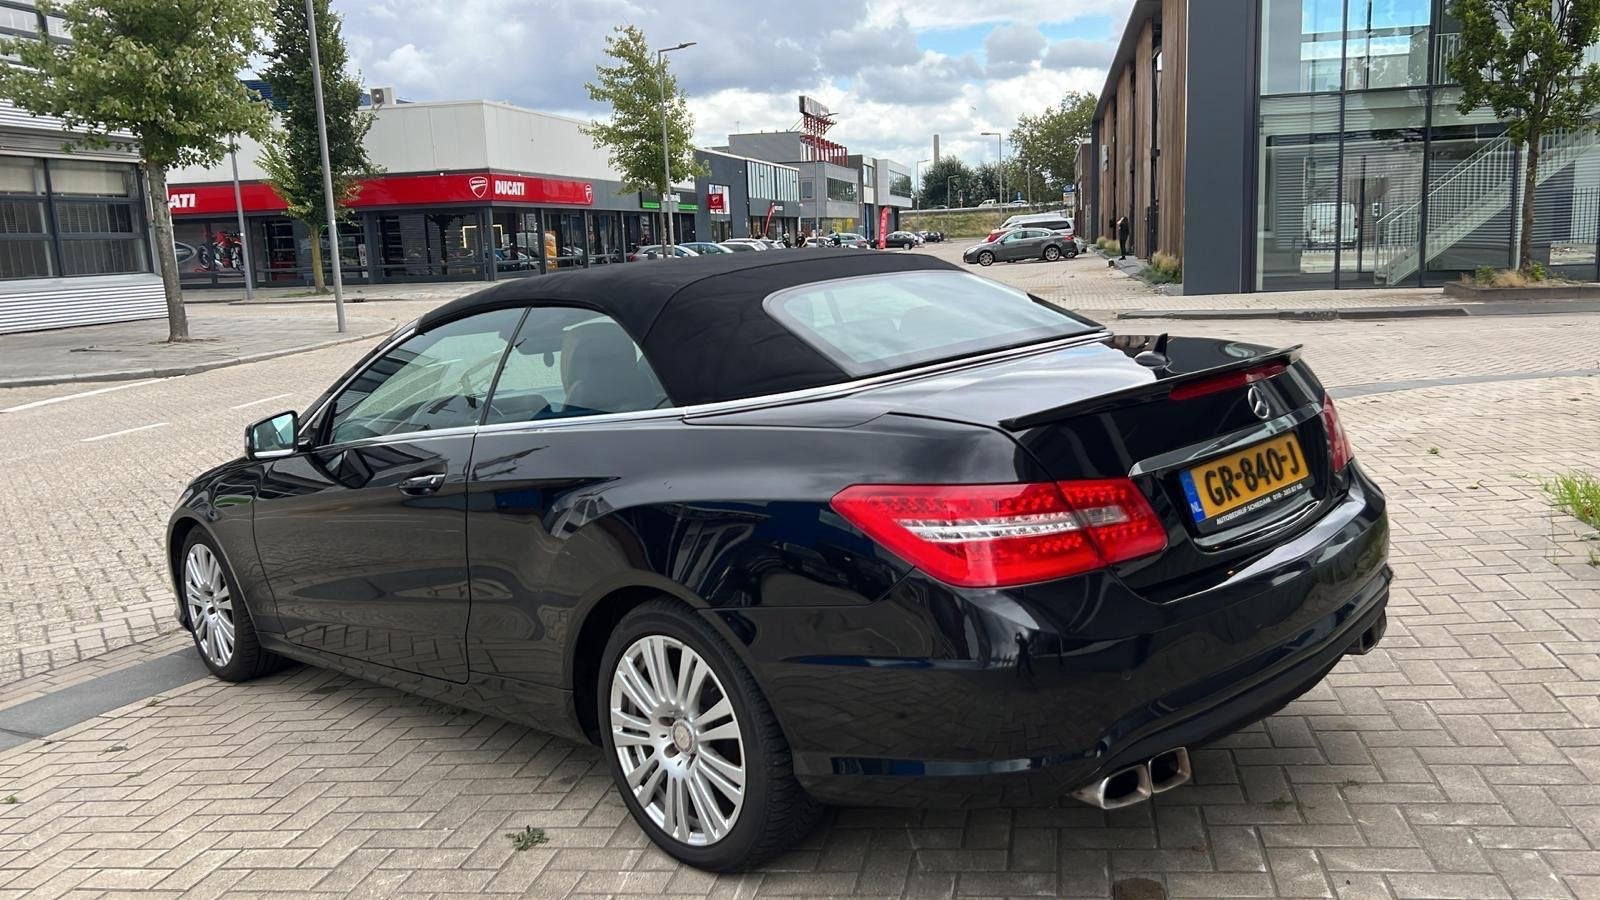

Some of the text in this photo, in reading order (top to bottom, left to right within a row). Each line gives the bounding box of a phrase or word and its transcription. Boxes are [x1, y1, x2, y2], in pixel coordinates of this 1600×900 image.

[495, 180, 525, 196] DUCATI
[1205, 441, 1299, 506] GR-840-J
[1190, 501, 1202, 514] NL
